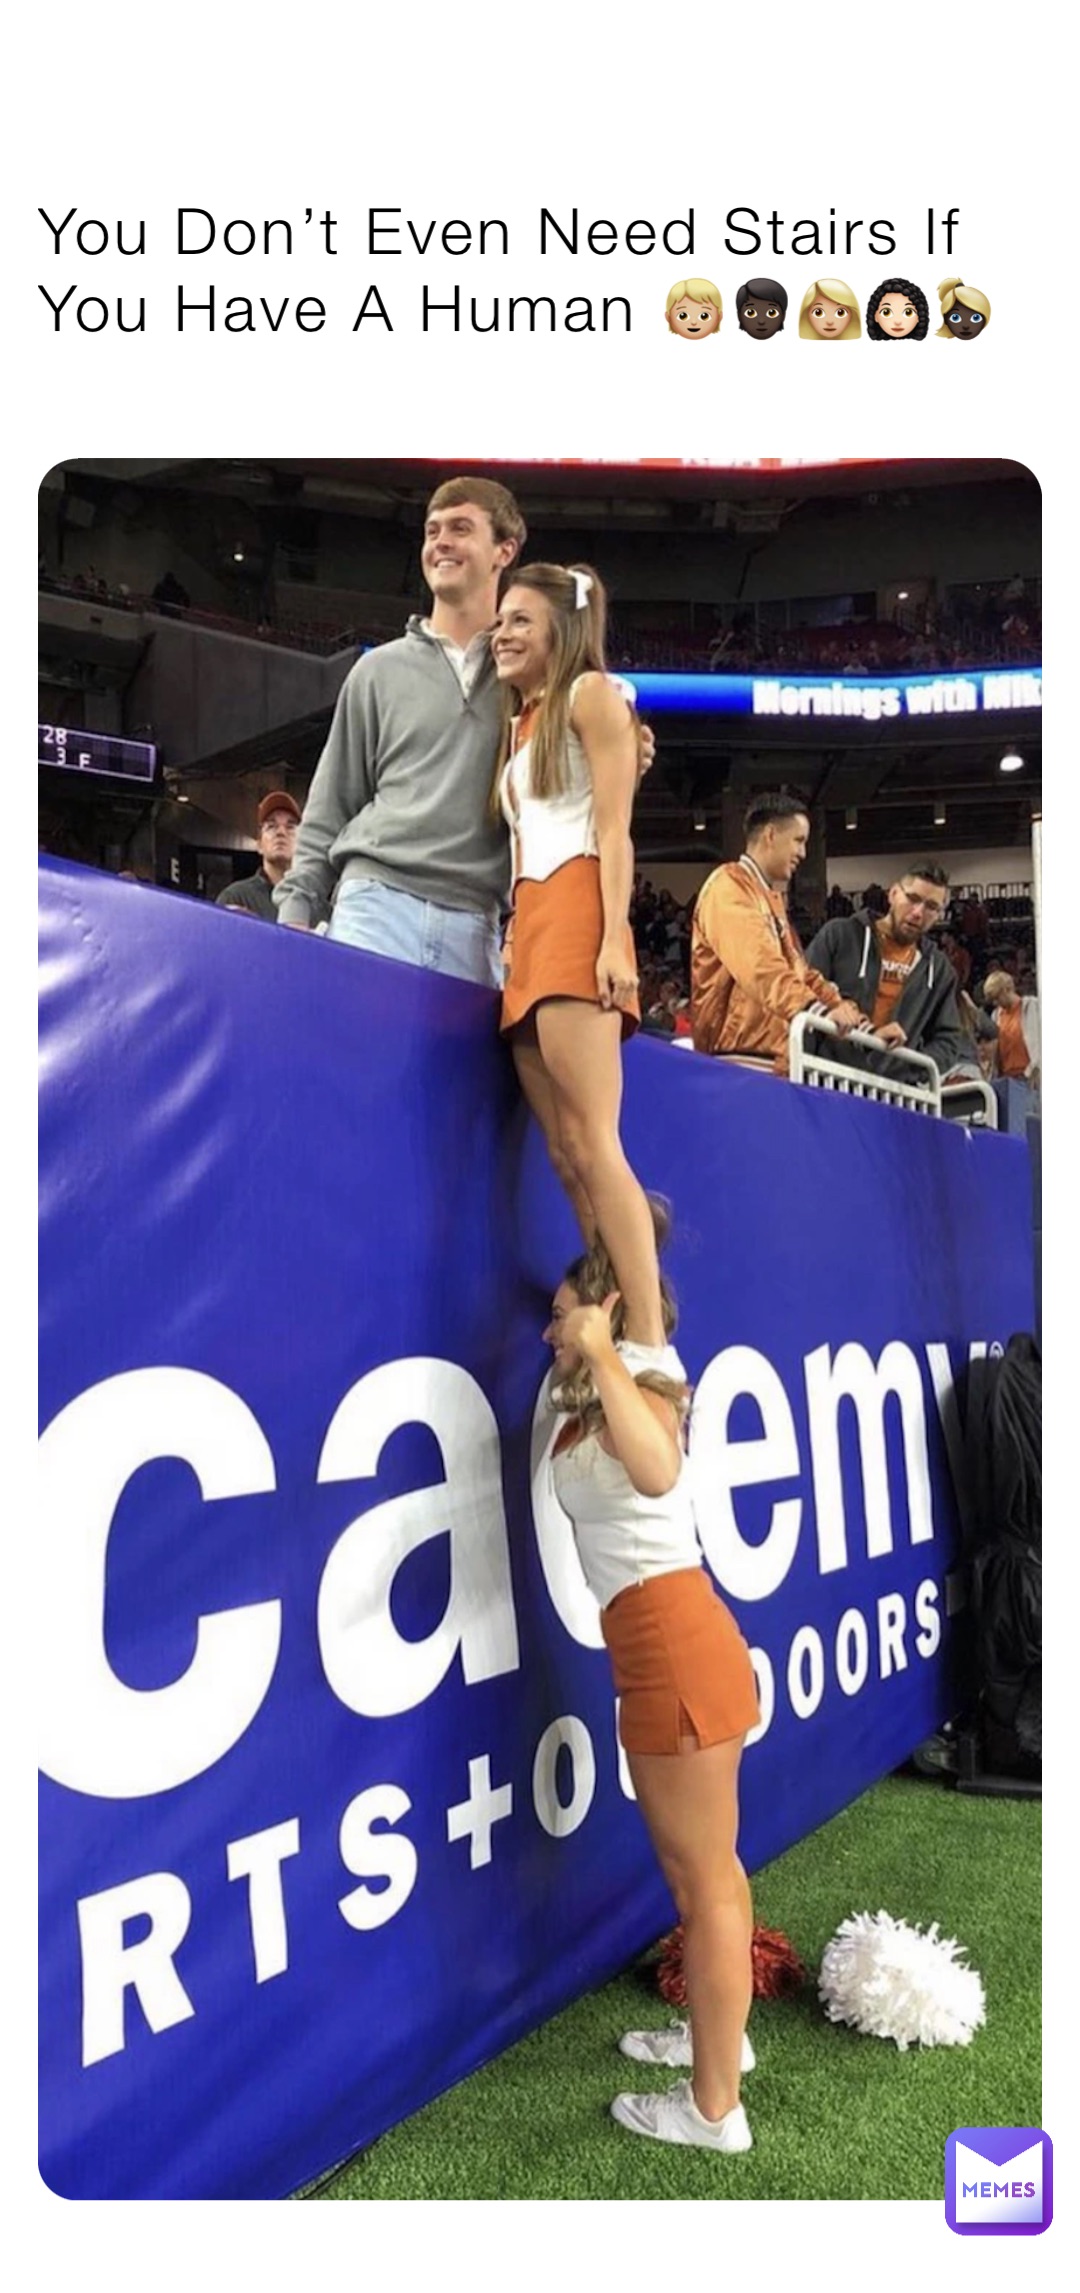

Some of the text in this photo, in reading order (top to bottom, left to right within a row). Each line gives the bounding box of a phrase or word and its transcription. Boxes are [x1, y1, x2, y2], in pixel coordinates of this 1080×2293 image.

[753, 680, 900, 720] Mornings
[905, 678, 977, 715] with
[42, 726, 67, 745] 28
[57, 748, 66, 766] 3
